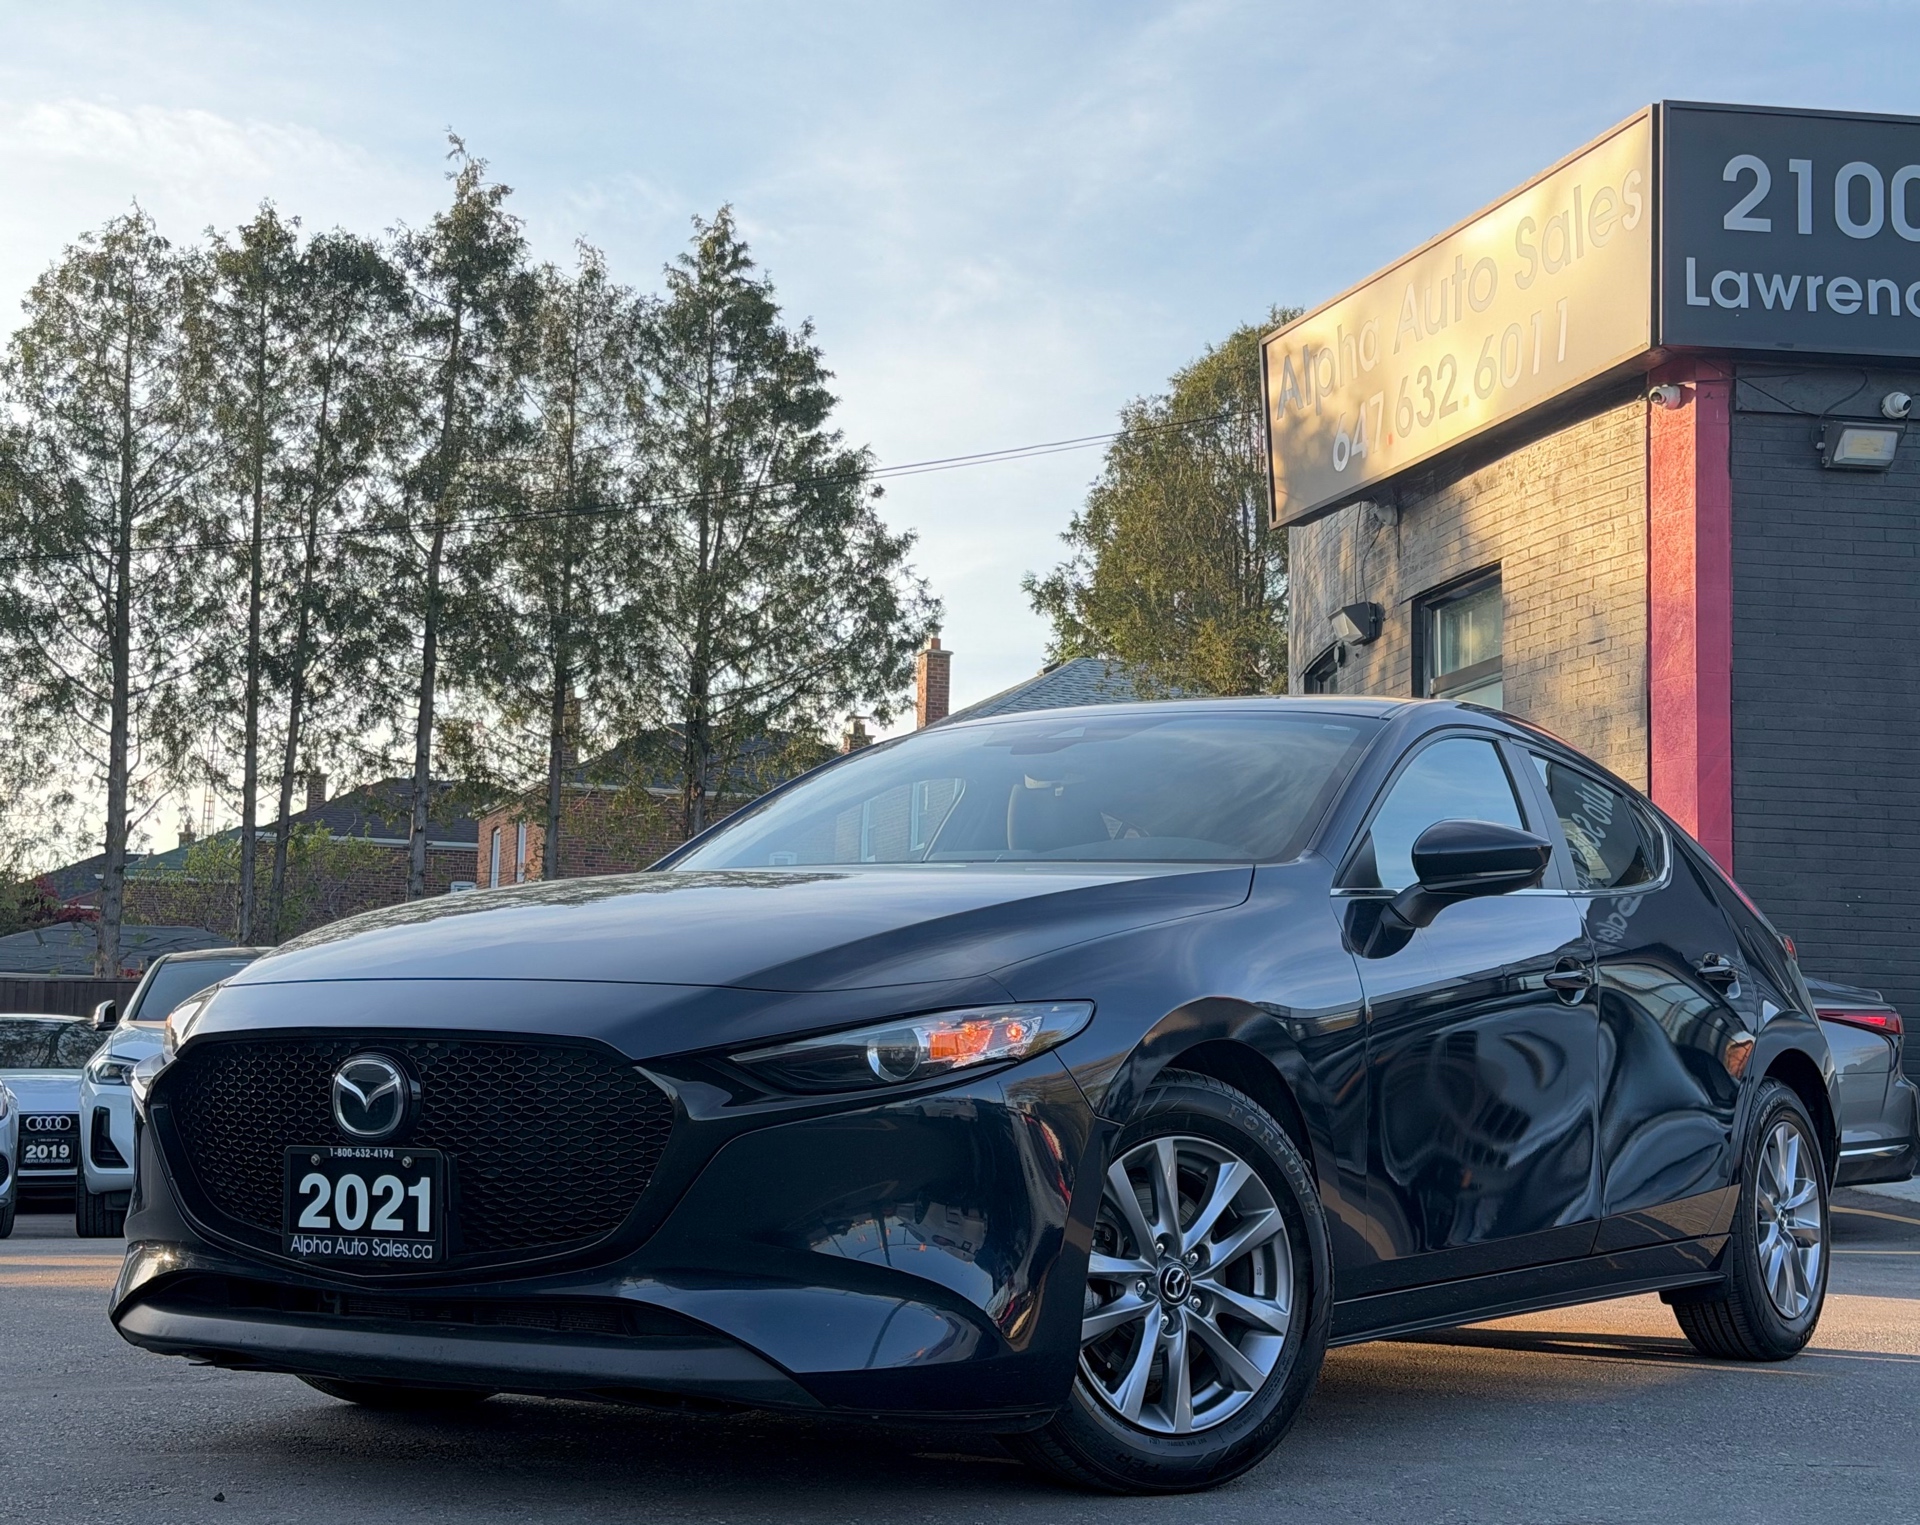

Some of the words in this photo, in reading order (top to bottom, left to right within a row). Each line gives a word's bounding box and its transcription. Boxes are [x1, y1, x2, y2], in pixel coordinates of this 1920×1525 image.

[1722, 154, 1920, 242] 2100
[1276, 315, 1381, 421] Alpha
[1393, 253, 1498, 355] Auto
[1514, 169, 1643, 290] Sales
[1332, 296, 1569, 472] 647.632.6011
[25, 1144, 70, 1159] 2019
[329, 1147, 395, 1159] 1-800-632-4194
[1226, 1103, 1318, 1216] FORTUNE
[298, 1172, 431, 1233] 2021
[290, 1235, 332, 1257] Alpha
[335, 1237, 369, 1256] Auto
[372, 1238, 433, 1260] Sales.ca
